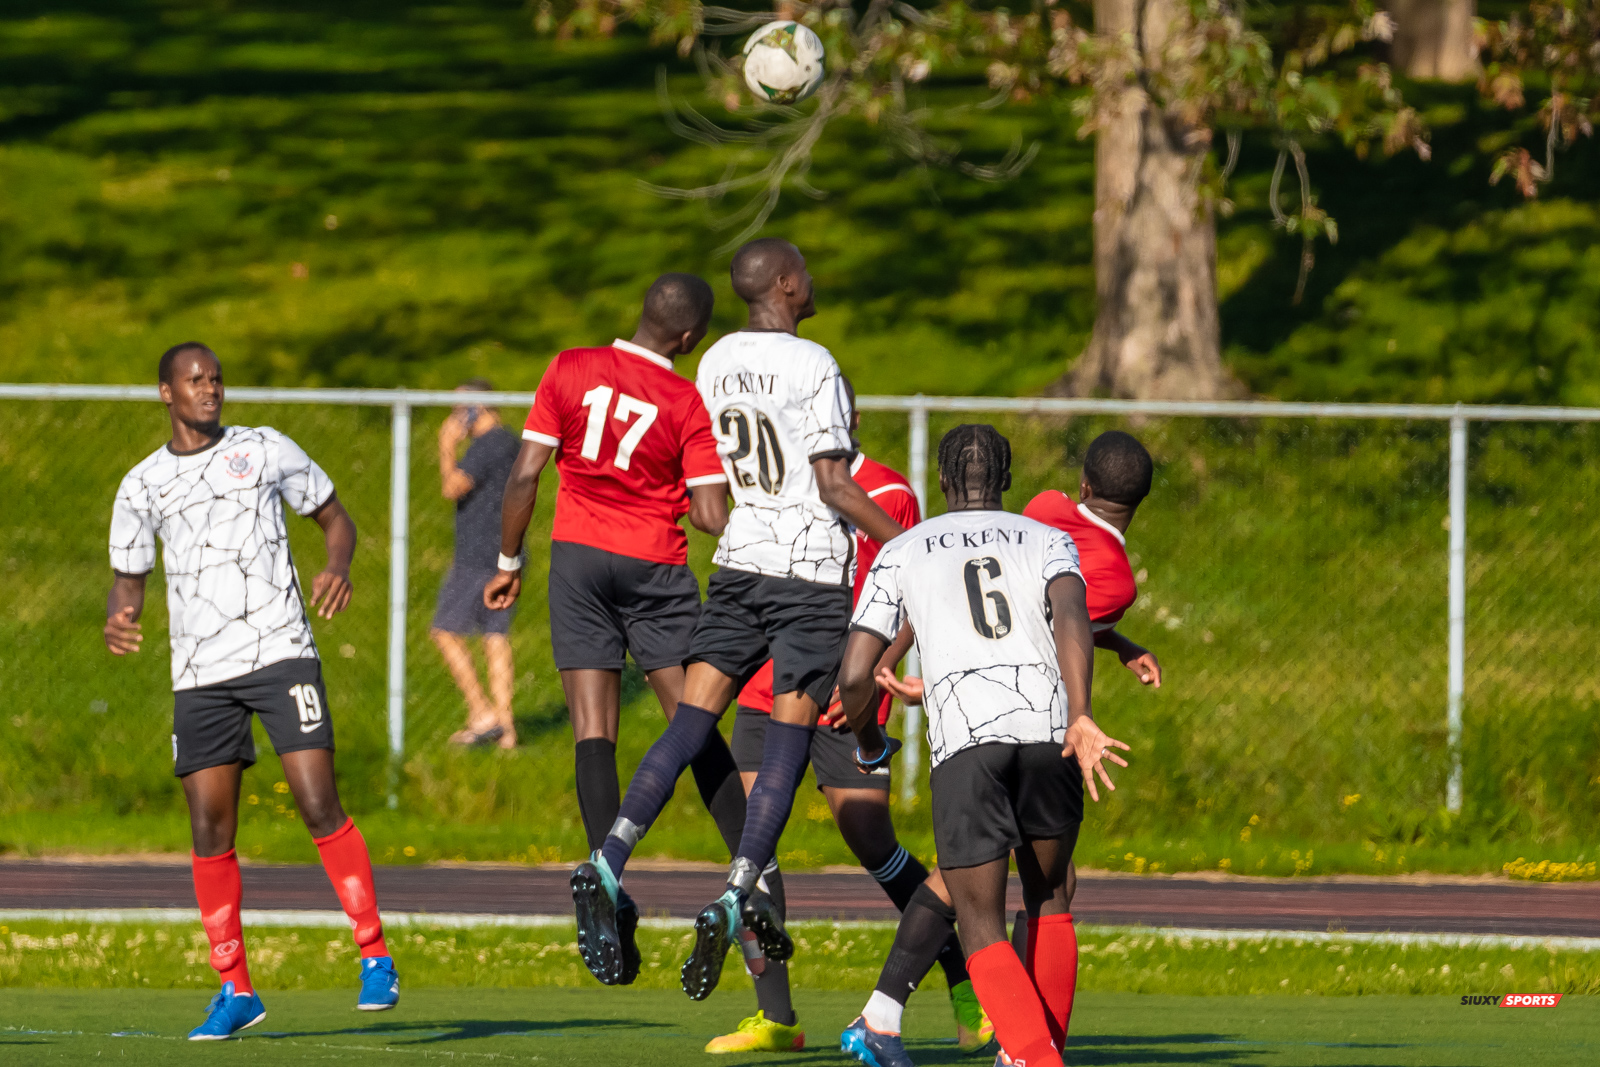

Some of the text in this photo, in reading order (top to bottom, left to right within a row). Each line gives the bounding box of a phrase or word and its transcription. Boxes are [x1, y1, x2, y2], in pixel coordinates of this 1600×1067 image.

[713, 375, 734, 399] FC
[581, 384, 659, 472] 17
[719, 408, 785, 496] 20
[924, 528, 1028, 554] FC KENT
[963, 556, 1012, 640] 6
[288, 683, 322, 722] 19
